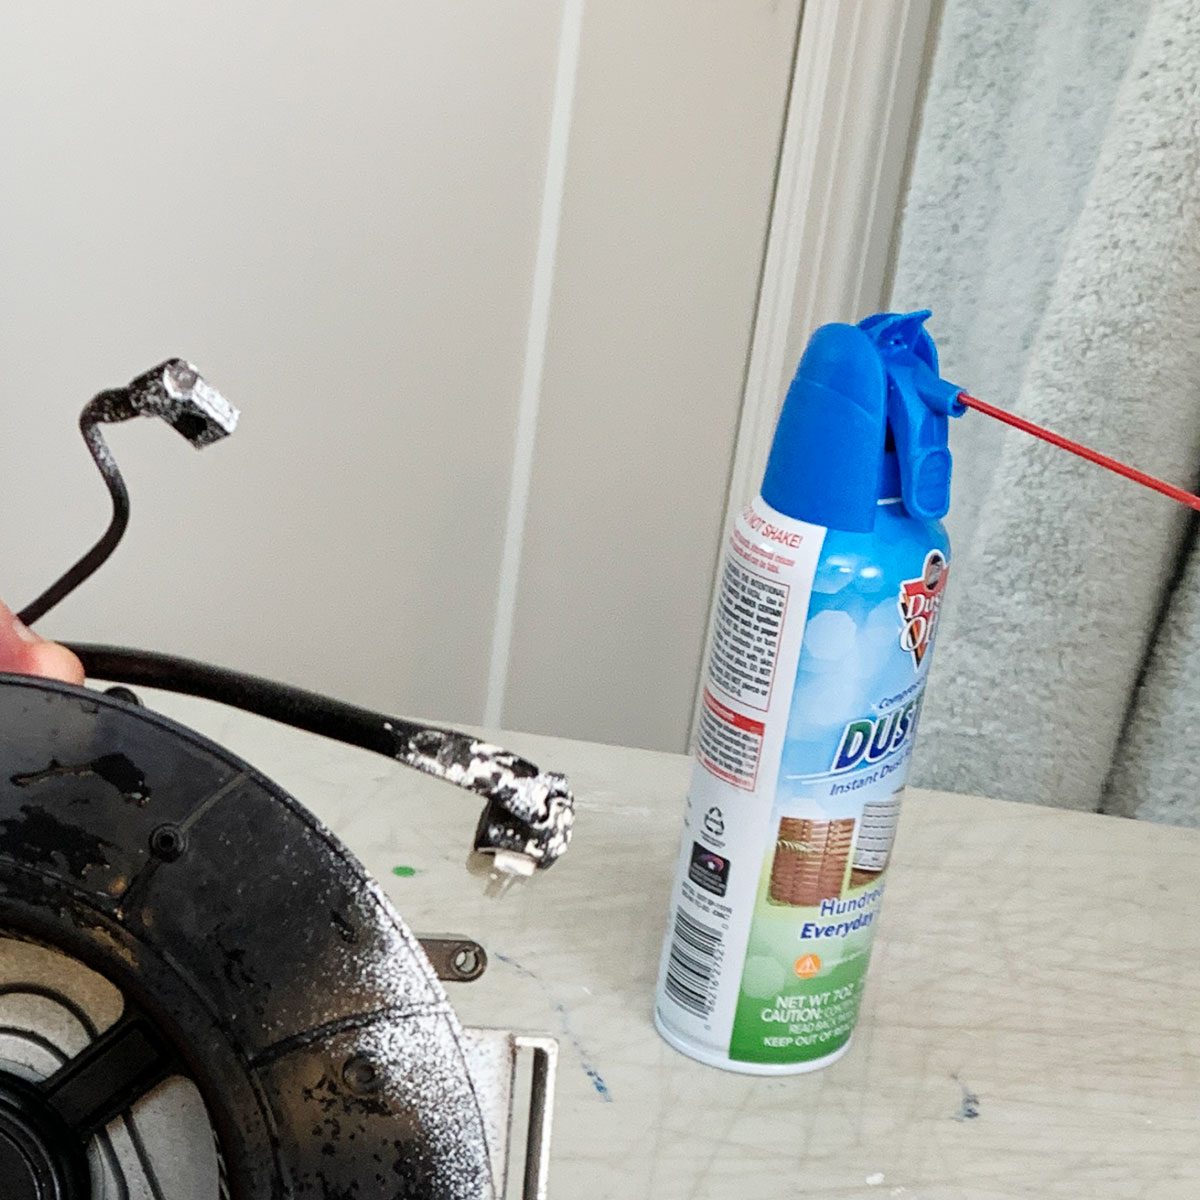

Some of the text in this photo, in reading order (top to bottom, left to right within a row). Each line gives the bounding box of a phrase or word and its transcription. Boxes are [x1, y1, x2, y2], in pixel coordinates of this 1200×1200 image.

[761, 523, 804, 549] SHAKE!
[830, 772, 878, 796] Instant
[776, 996, 804, 1009] NET
